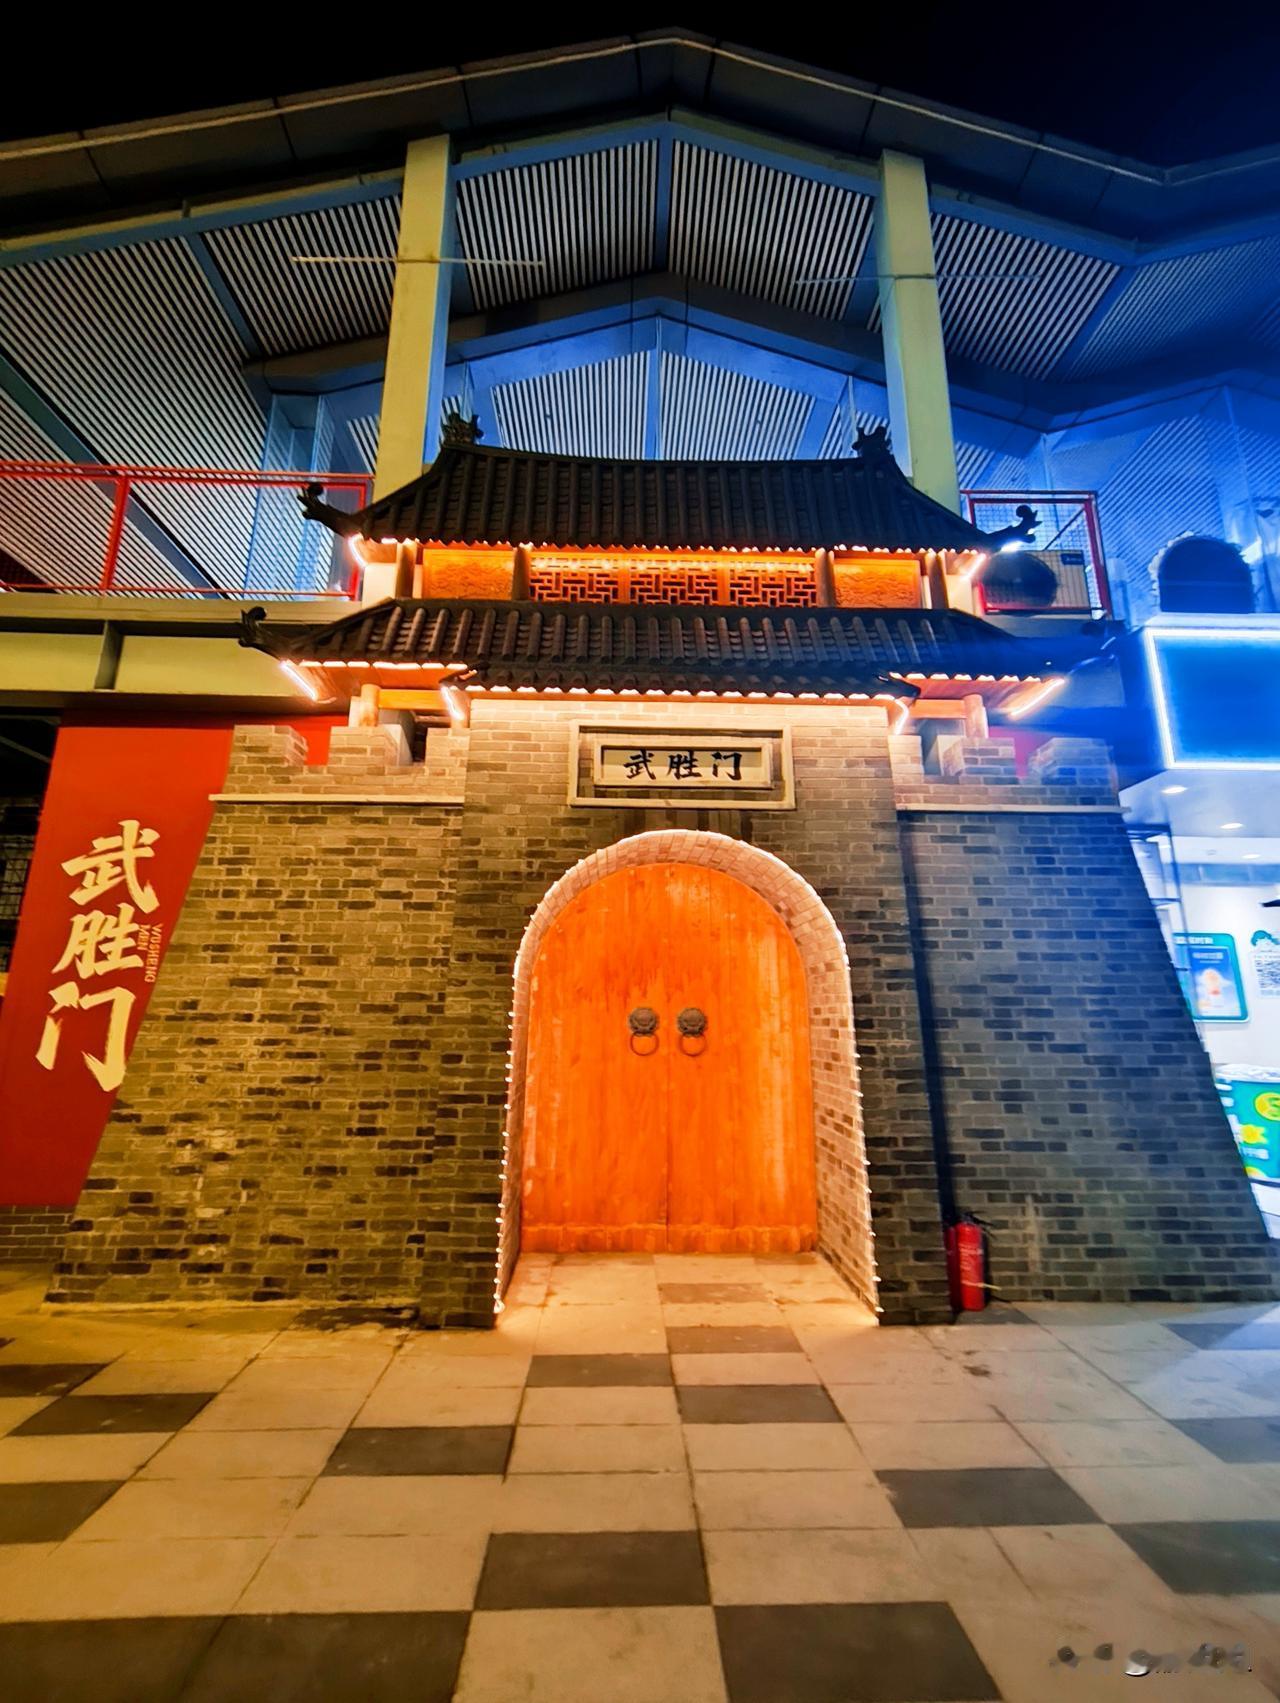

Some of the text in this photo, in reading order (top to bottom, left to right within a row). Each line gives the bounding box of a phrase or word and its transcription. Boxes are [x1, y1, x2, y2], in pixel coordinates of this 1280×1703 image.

[623, 749, 743, 781] 武胜门
[35, 819, 161, 1092] 武胜门
[144, 922, 164, 983] WUSHENG
